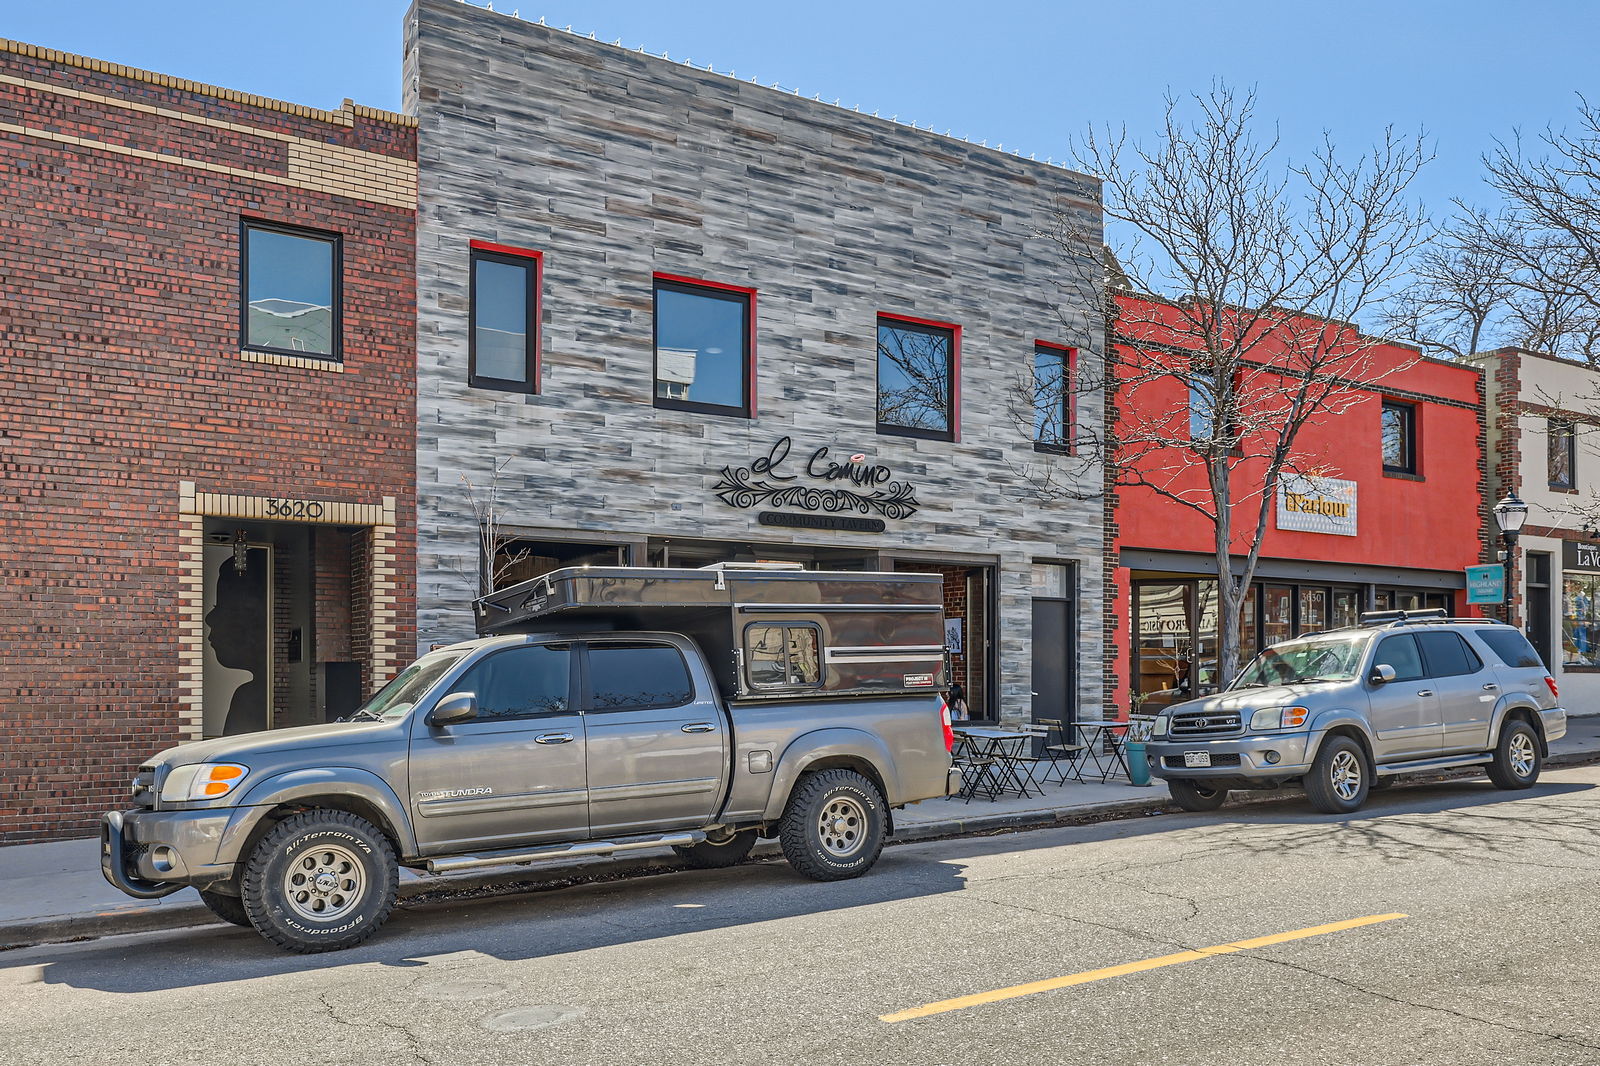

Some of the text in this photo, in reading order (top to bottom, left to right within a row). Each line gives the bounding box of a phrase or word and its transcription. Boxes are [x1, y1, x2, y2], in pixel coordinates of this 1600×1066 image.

[806, 446, 892, 488] Camino
[265, 498, 323, 518] 3620
[766, 513, 881, 530] COMMUNITY TAVERN
[1301, 592, 1322, 602] 3630
[443, 787, 493, 797] TUNDRA
[864, 796, 876, 811] T/A
[286, 830, 372, 856] All-Terrain T/A
[816, 849, 865, 869] BFGoodrich
[285, 913, 364, 936] BFGoodrich
